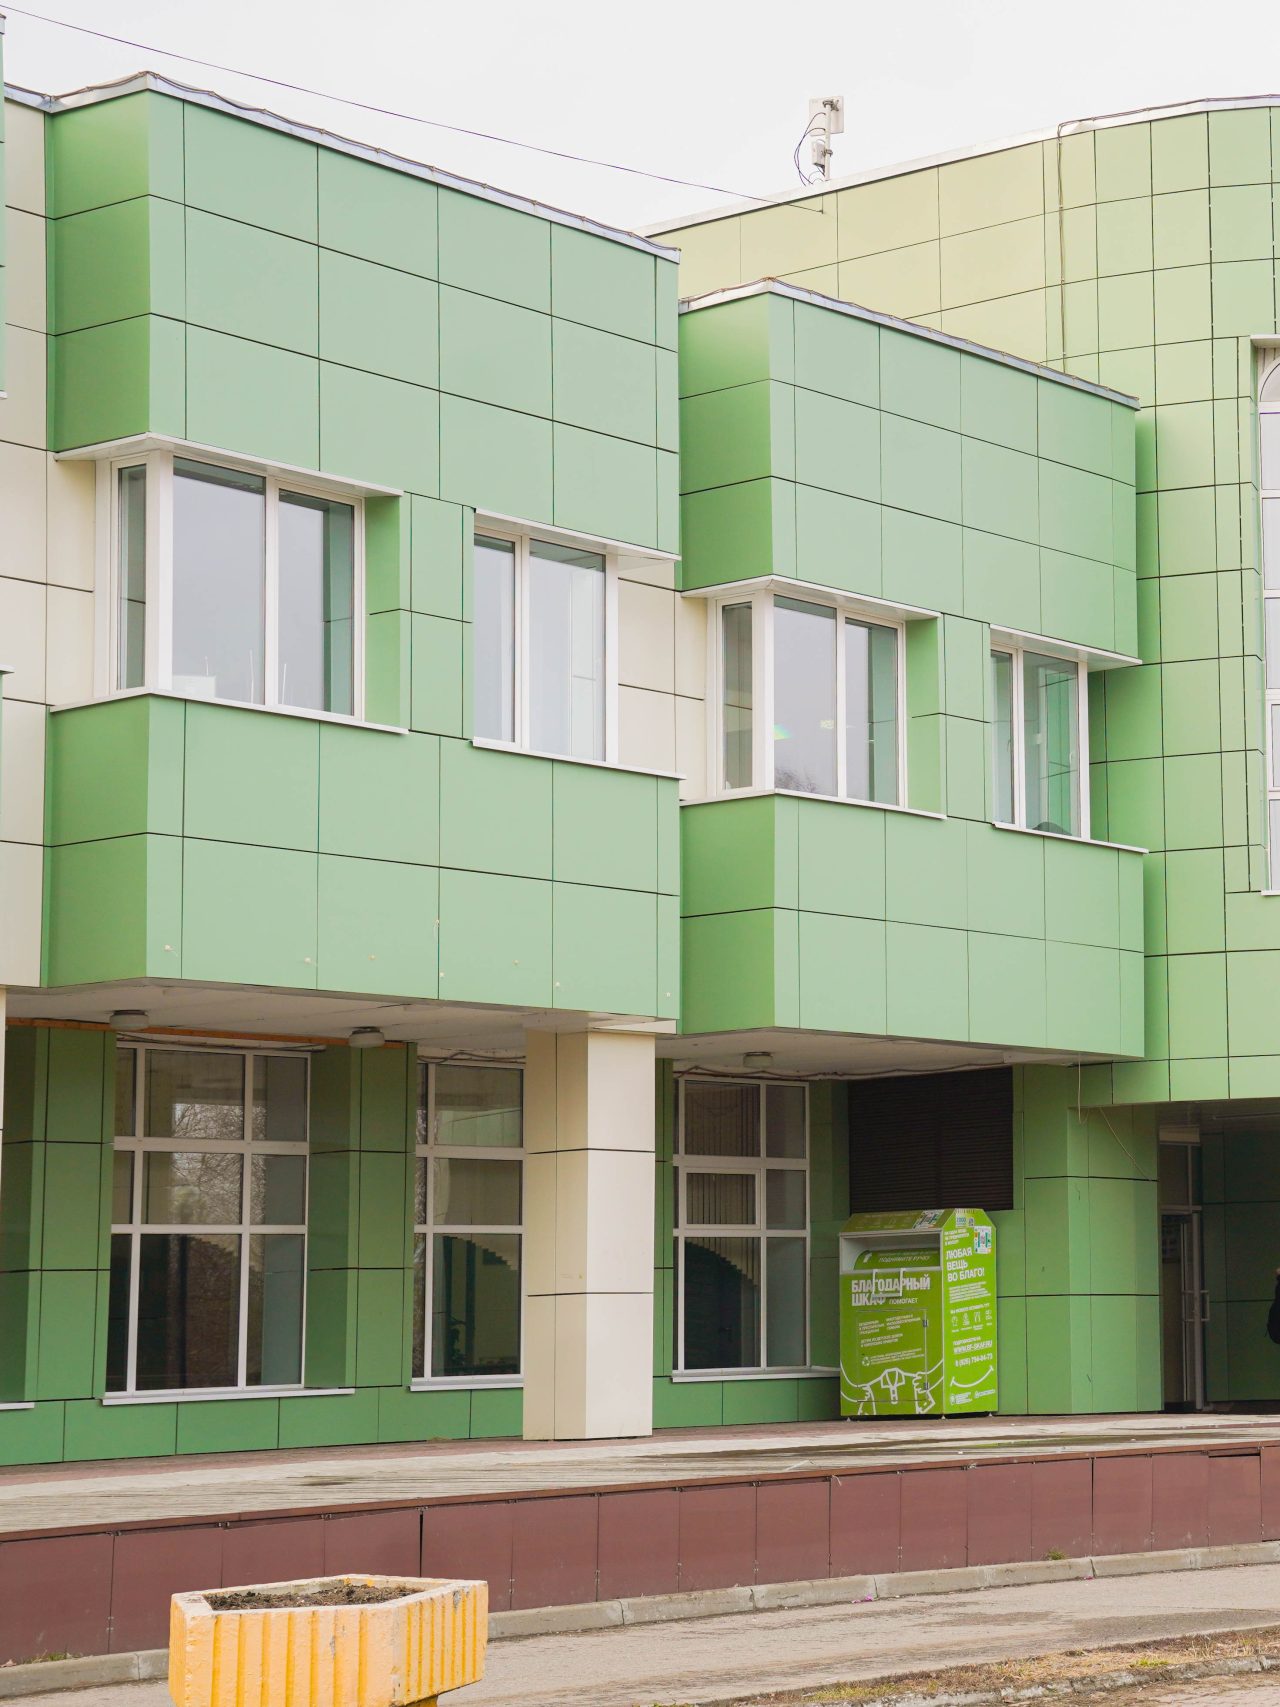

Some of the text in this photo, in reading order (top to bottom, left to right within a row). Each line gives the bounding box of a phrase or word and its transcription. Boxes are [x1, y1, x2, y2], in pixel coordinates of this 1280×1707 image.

[946, 1247, 972, 1260] ЛЮБАЯ
[947, 1260, 968, 1270] ВЕЩЬ
[948, 1267, 985, 1282] ВО БЛАГО!
[851, 1274, 931, 1293] БЛАГОДАРНЫЙ
[851, 1293, 886, 1306] ШКАФ
